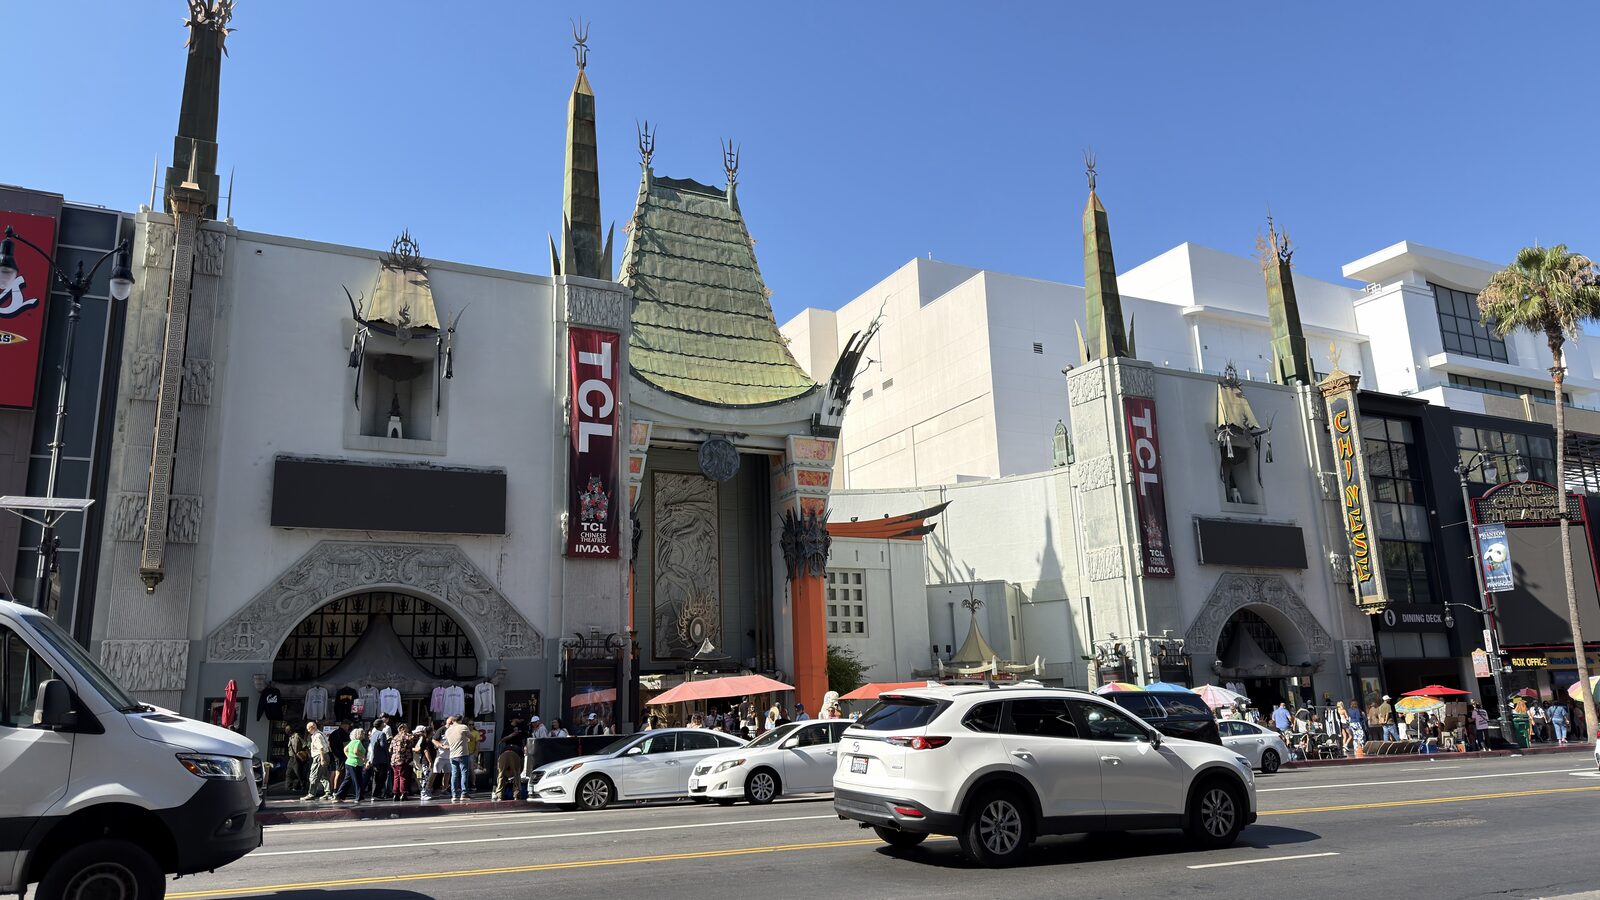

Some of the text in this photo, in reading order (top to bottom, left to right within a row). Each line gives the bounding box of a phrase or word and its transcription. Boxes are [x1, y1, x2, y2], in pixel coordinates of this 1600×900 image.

[578, 342, 614, 453] TCL
[1132, 408, 1159, 497] TCL
[1510, 484, 1541, 496] TCL
[1333, 410, 1371, 583] CHINESE
[581, 522, 607, 532] TCL
[575, 544, 611, 554] IMAX
[1149, 549, 1165, 557] TCL
[1148, 566, 1170, 574] IMAX
[1402, 613, 1425, 622] DINING
[1425, 614, 1442, 623] DECK
[1511, 658, 1526, 667] BOX
[1526, 657, 1548, 666] OFFICE
